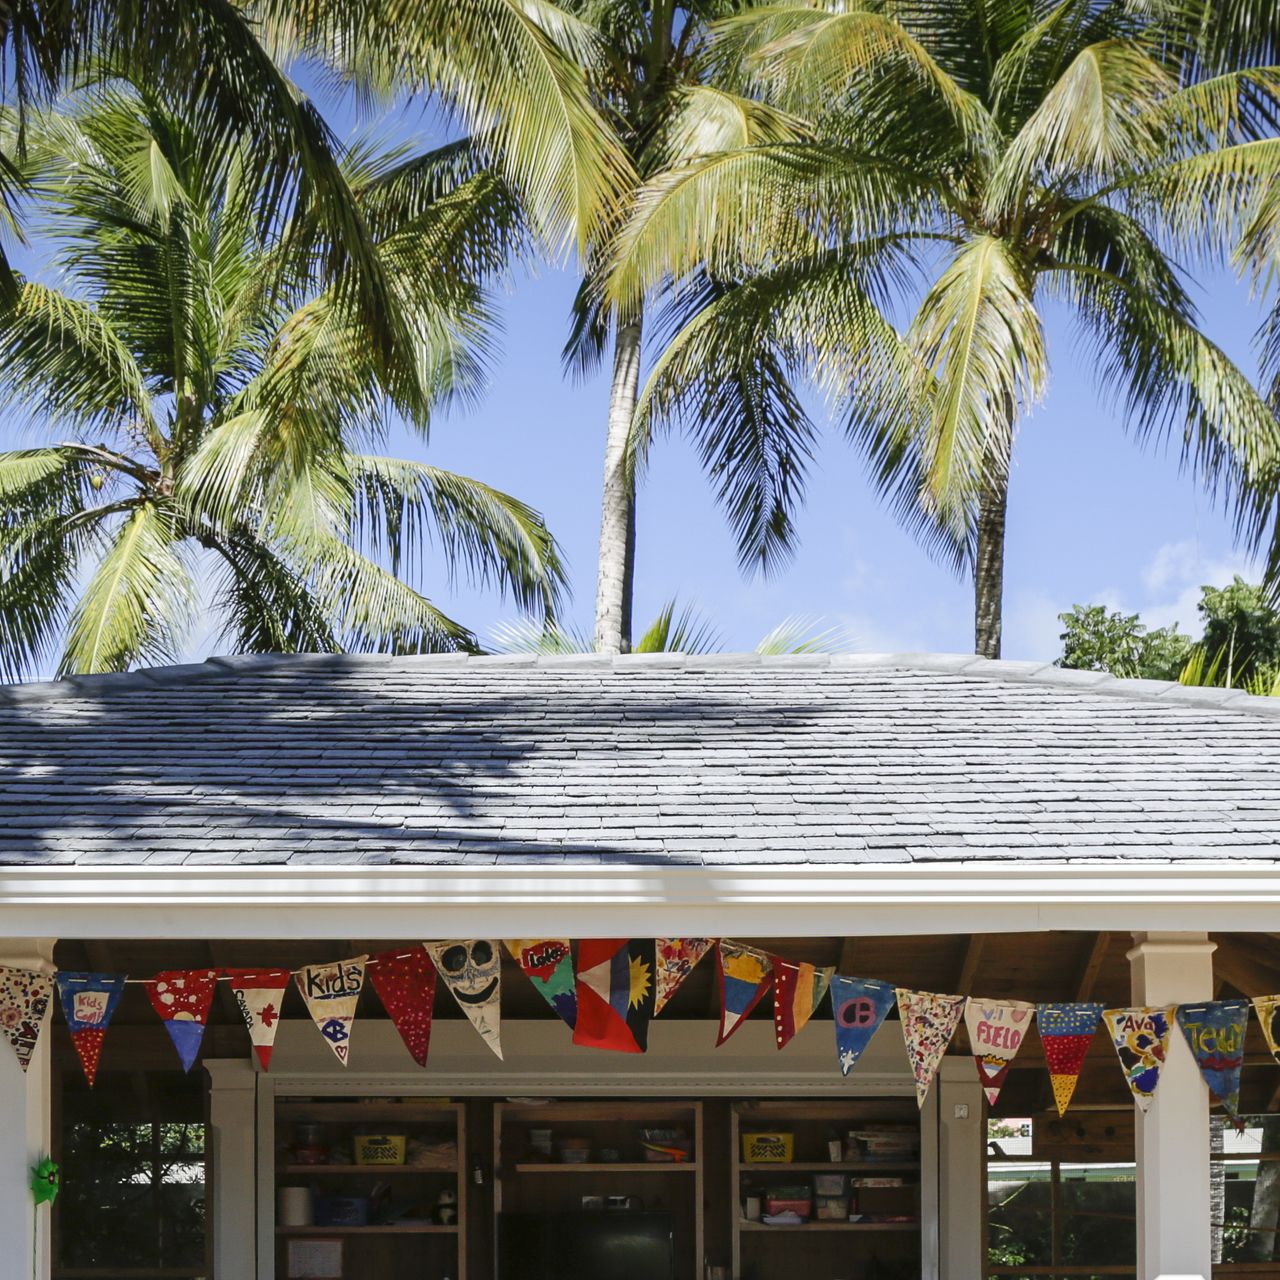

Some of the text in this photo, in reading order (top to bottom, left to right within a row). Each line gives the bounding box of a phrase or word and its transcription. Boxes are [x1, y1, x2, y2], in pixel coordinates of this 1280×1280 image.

[306, 963, 361, 997] Kids
[78, 994, 104, 1011] Kids
[235, 989, 254, 1030] CANADA
[976, 1020, 1022, 1050] FIELD
[1122, 1014, 1154, 1032] Ava
